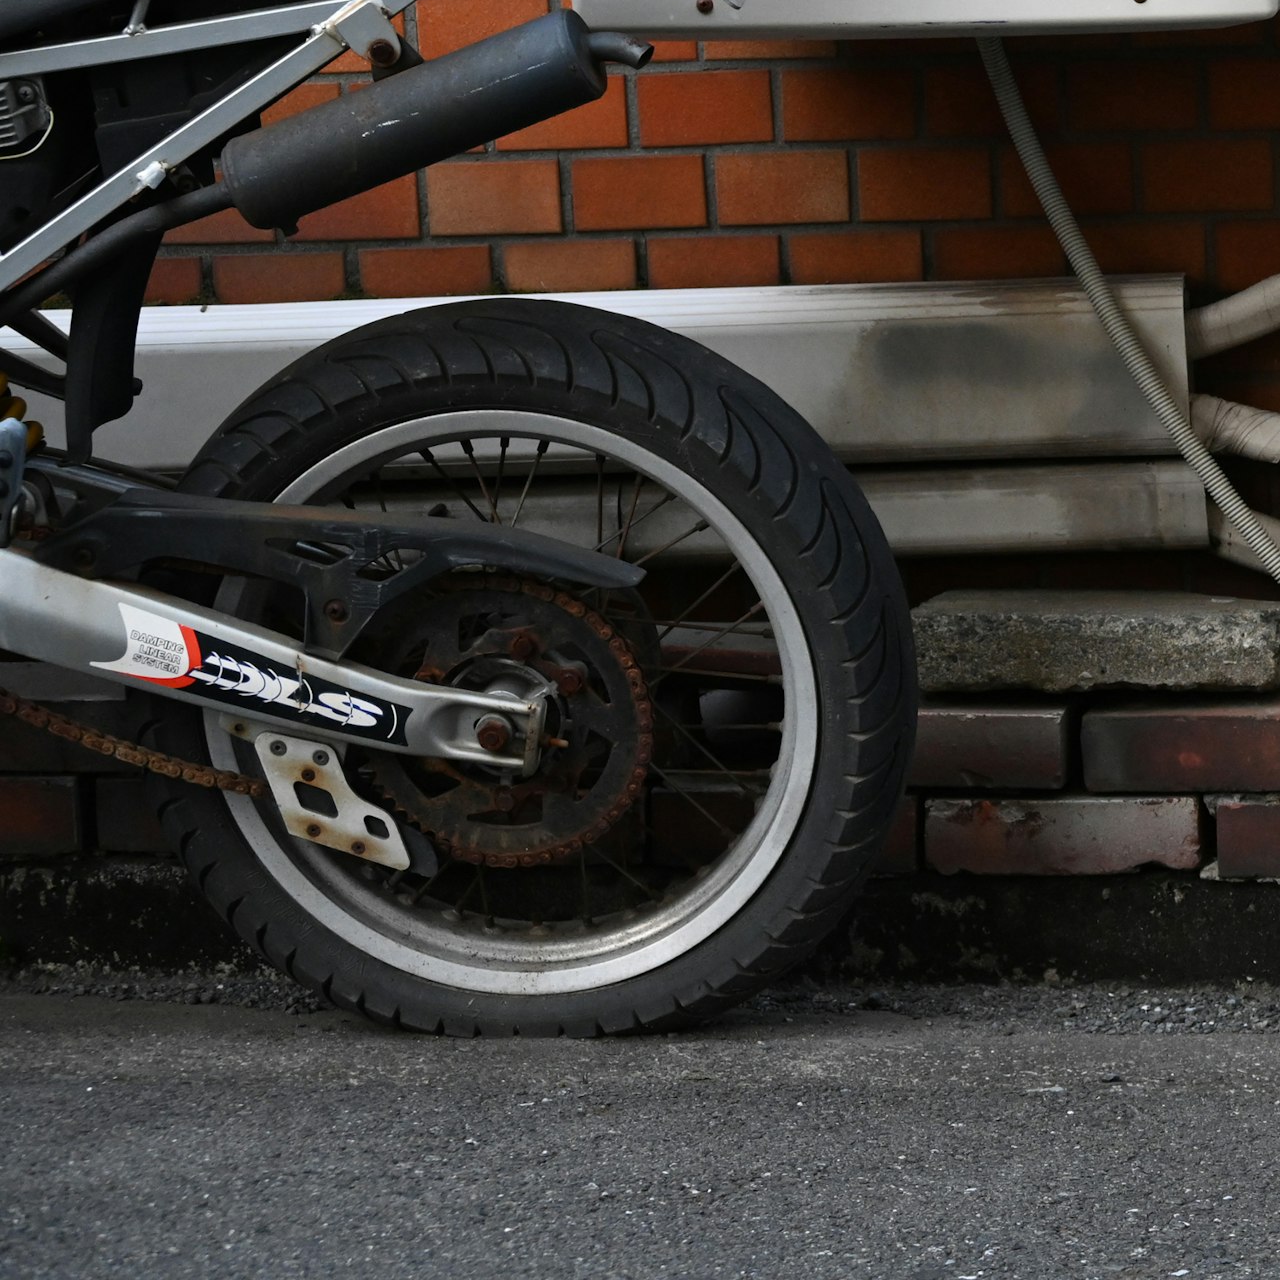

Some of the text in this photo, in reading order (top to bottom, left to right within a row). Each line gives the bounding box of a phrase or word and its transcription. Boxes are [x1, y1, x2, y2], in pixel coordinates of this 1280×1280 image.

[130, 629, 185, 655] DAMPING
[131, 652, 180, 675] SYSTEM
[138, 643, 182, 666] LINEAR
